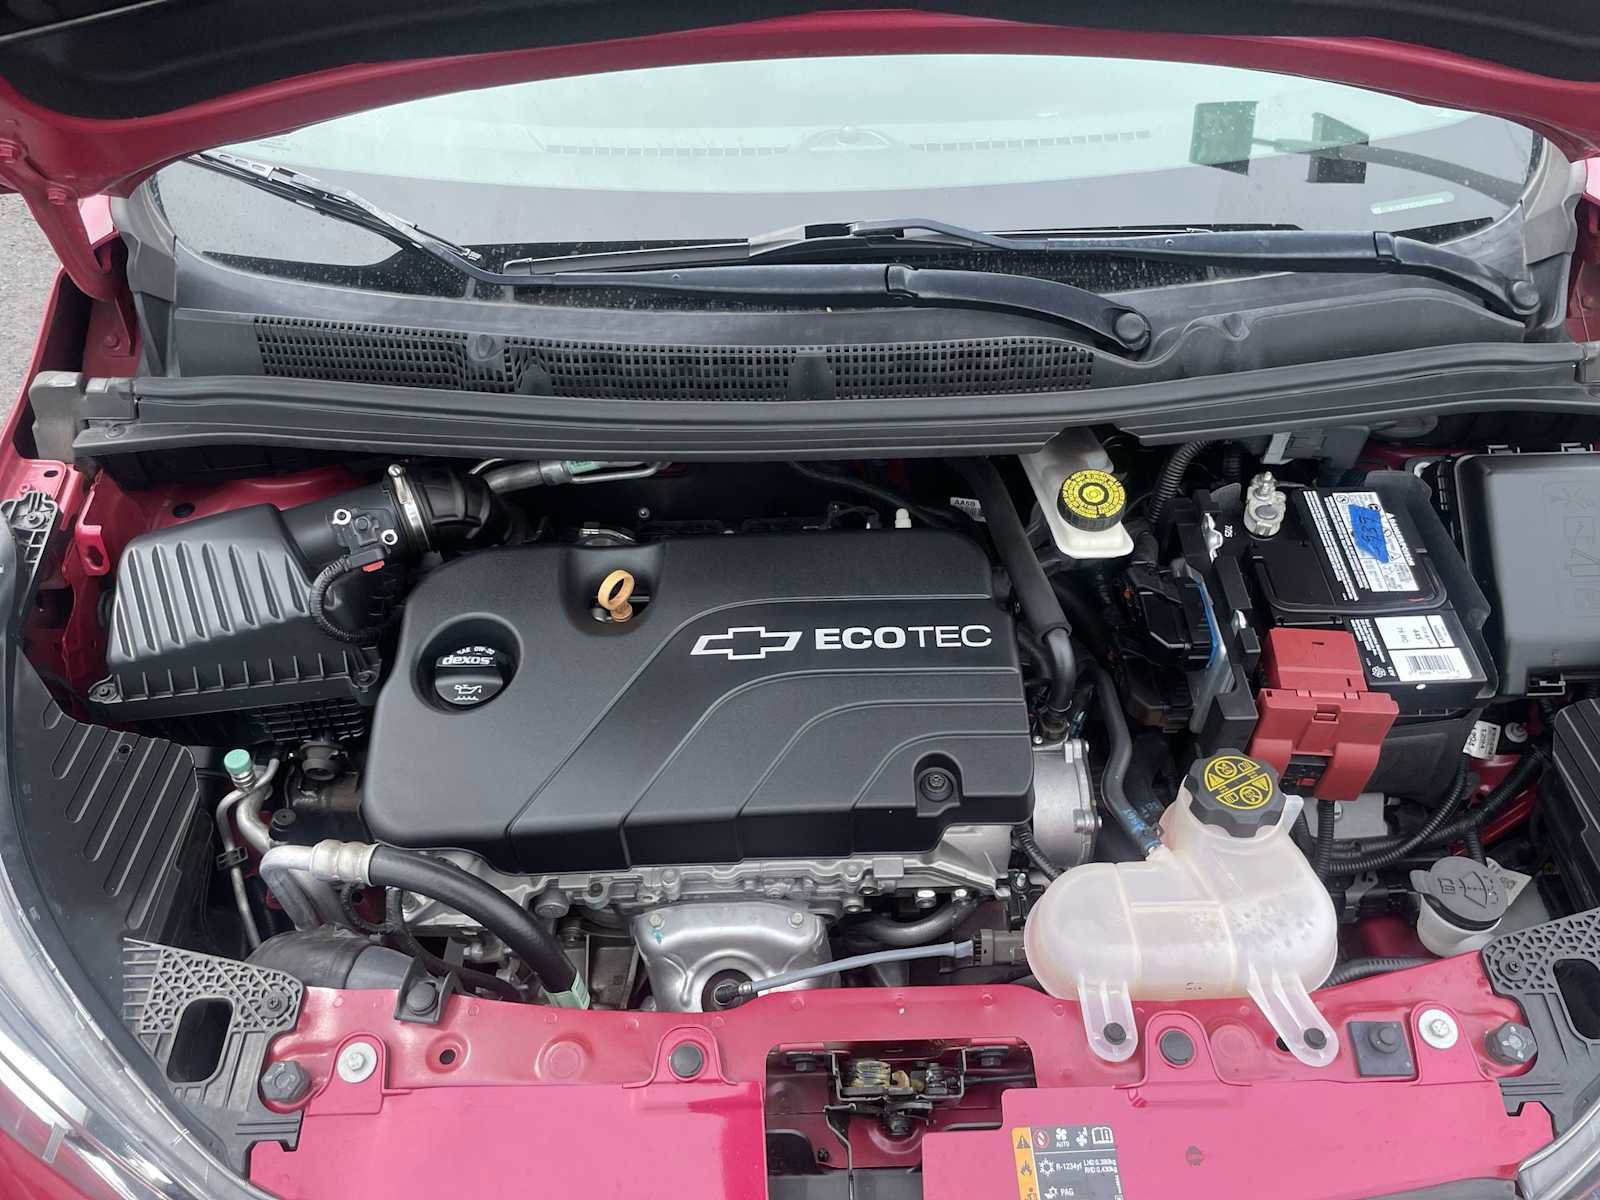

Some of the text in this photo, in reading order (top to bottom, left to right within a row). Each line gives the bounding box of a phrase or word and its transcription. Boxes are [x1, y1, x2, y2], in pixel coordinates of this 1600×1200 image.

[815, 624, 993, 650] ECOTEC
[442, 654, 491, 665] dexos
[1060, 1187, 1075, 1197] PAG
